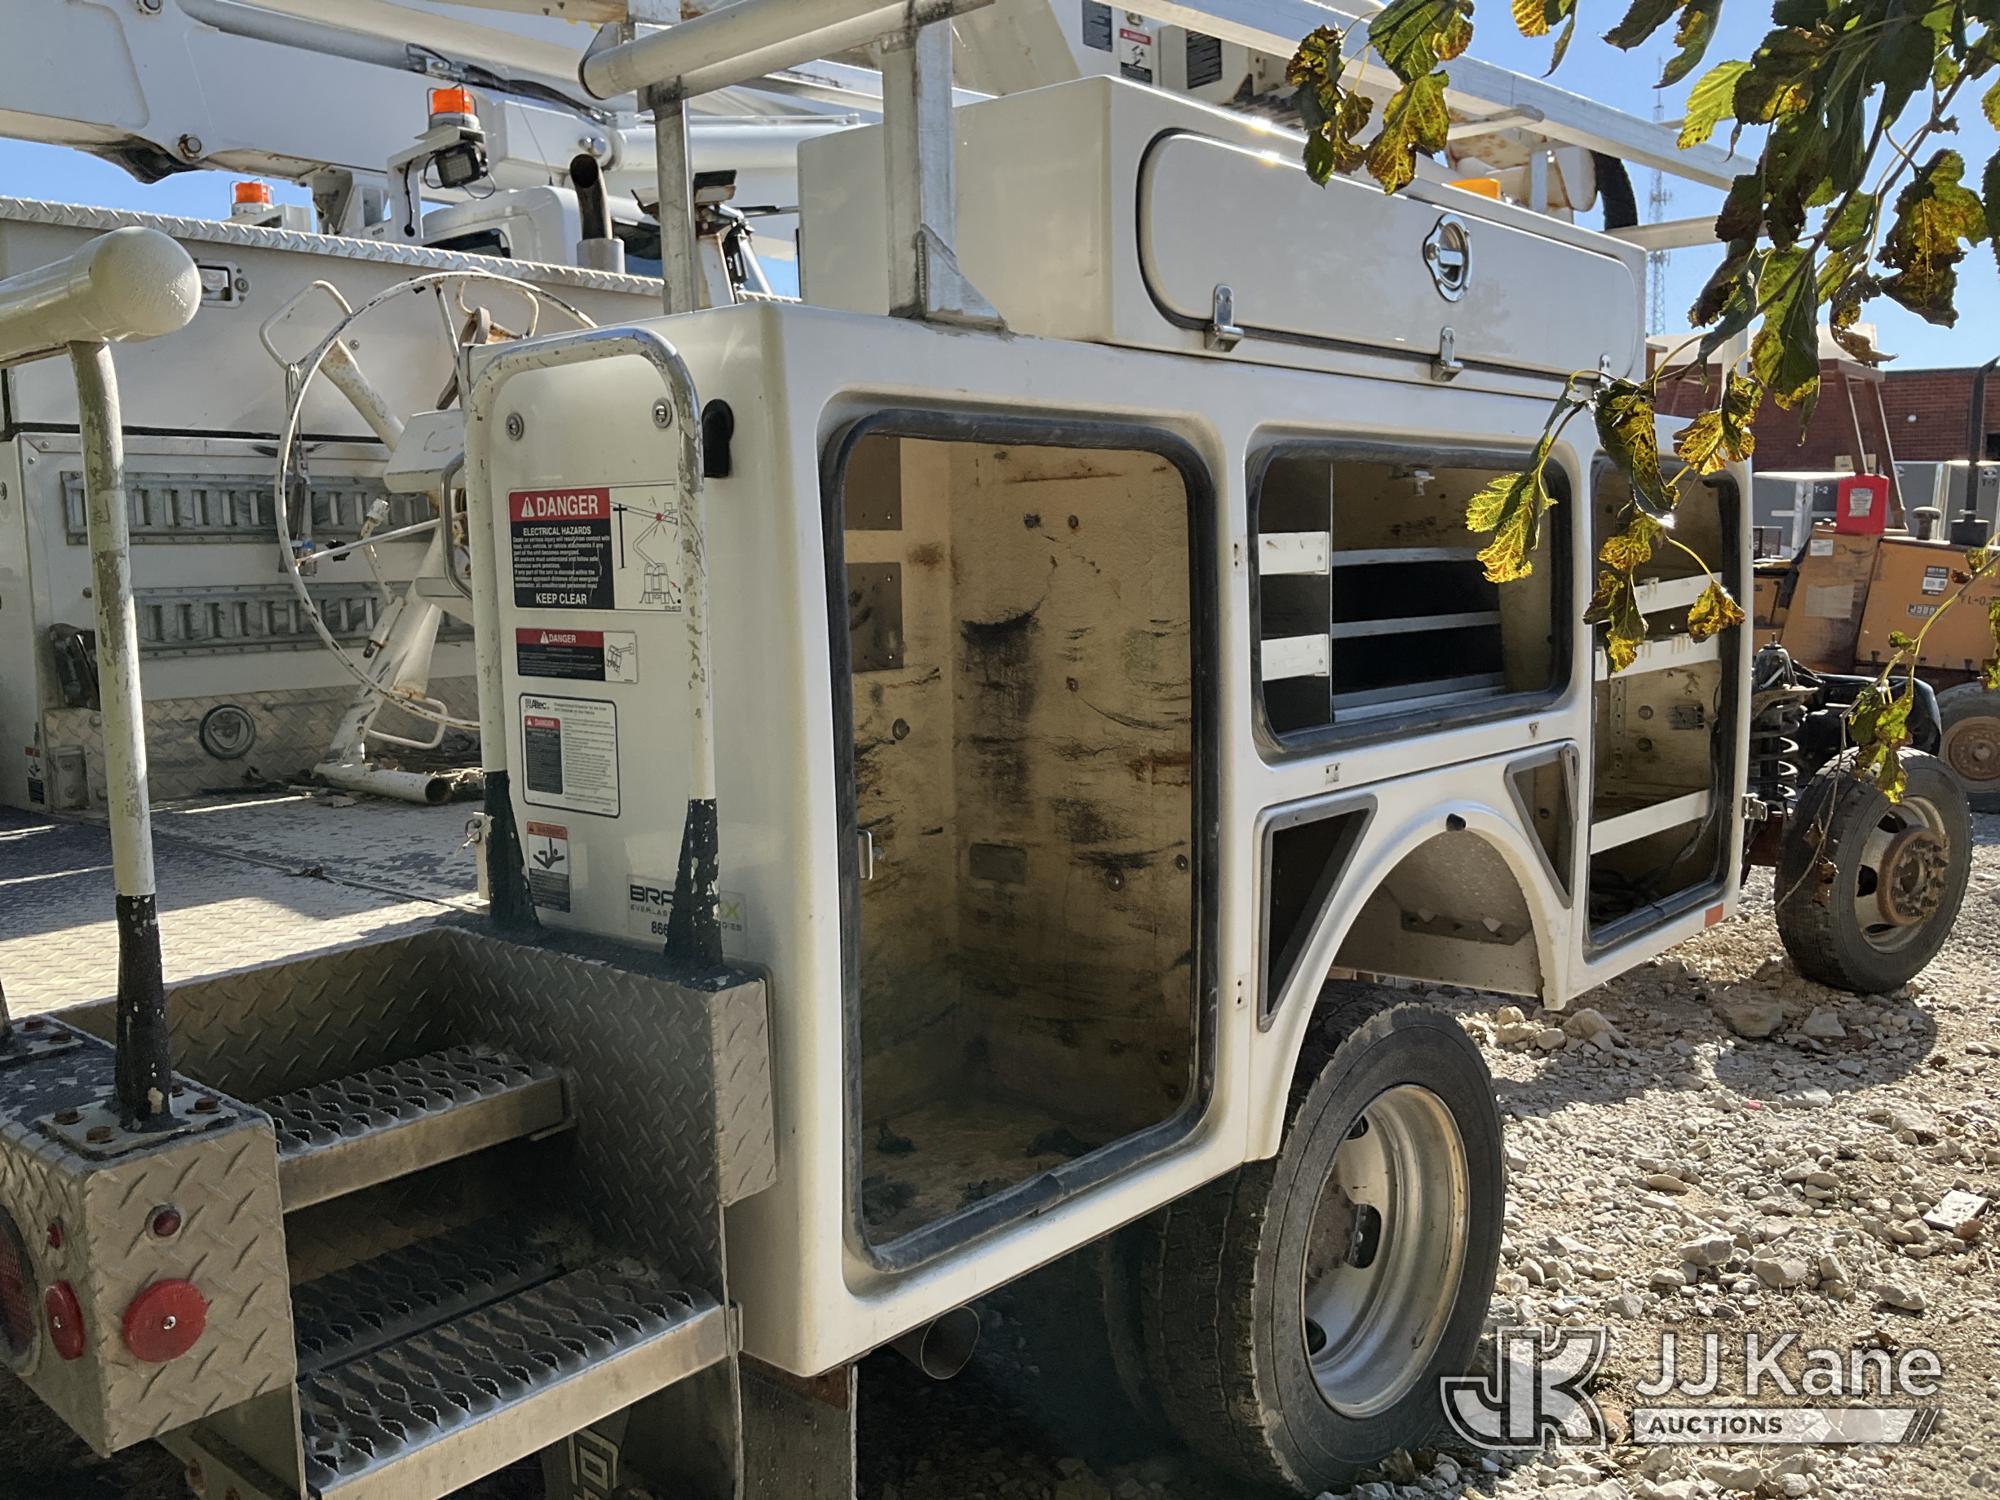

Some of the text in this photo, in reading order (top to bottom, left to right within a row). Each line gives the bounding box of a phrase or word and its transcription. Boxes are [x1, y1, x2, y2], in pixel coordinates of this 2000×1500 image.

[1814, 485, 1828, 494] T-2
[536, 494, 599, 517] DANGER
[523, 526, 592, 536] ELECTRICAL HAZARDS
[535, 592, 588, 605] KEEP CLEAR
[548, 633, 577, 644] DANGER
